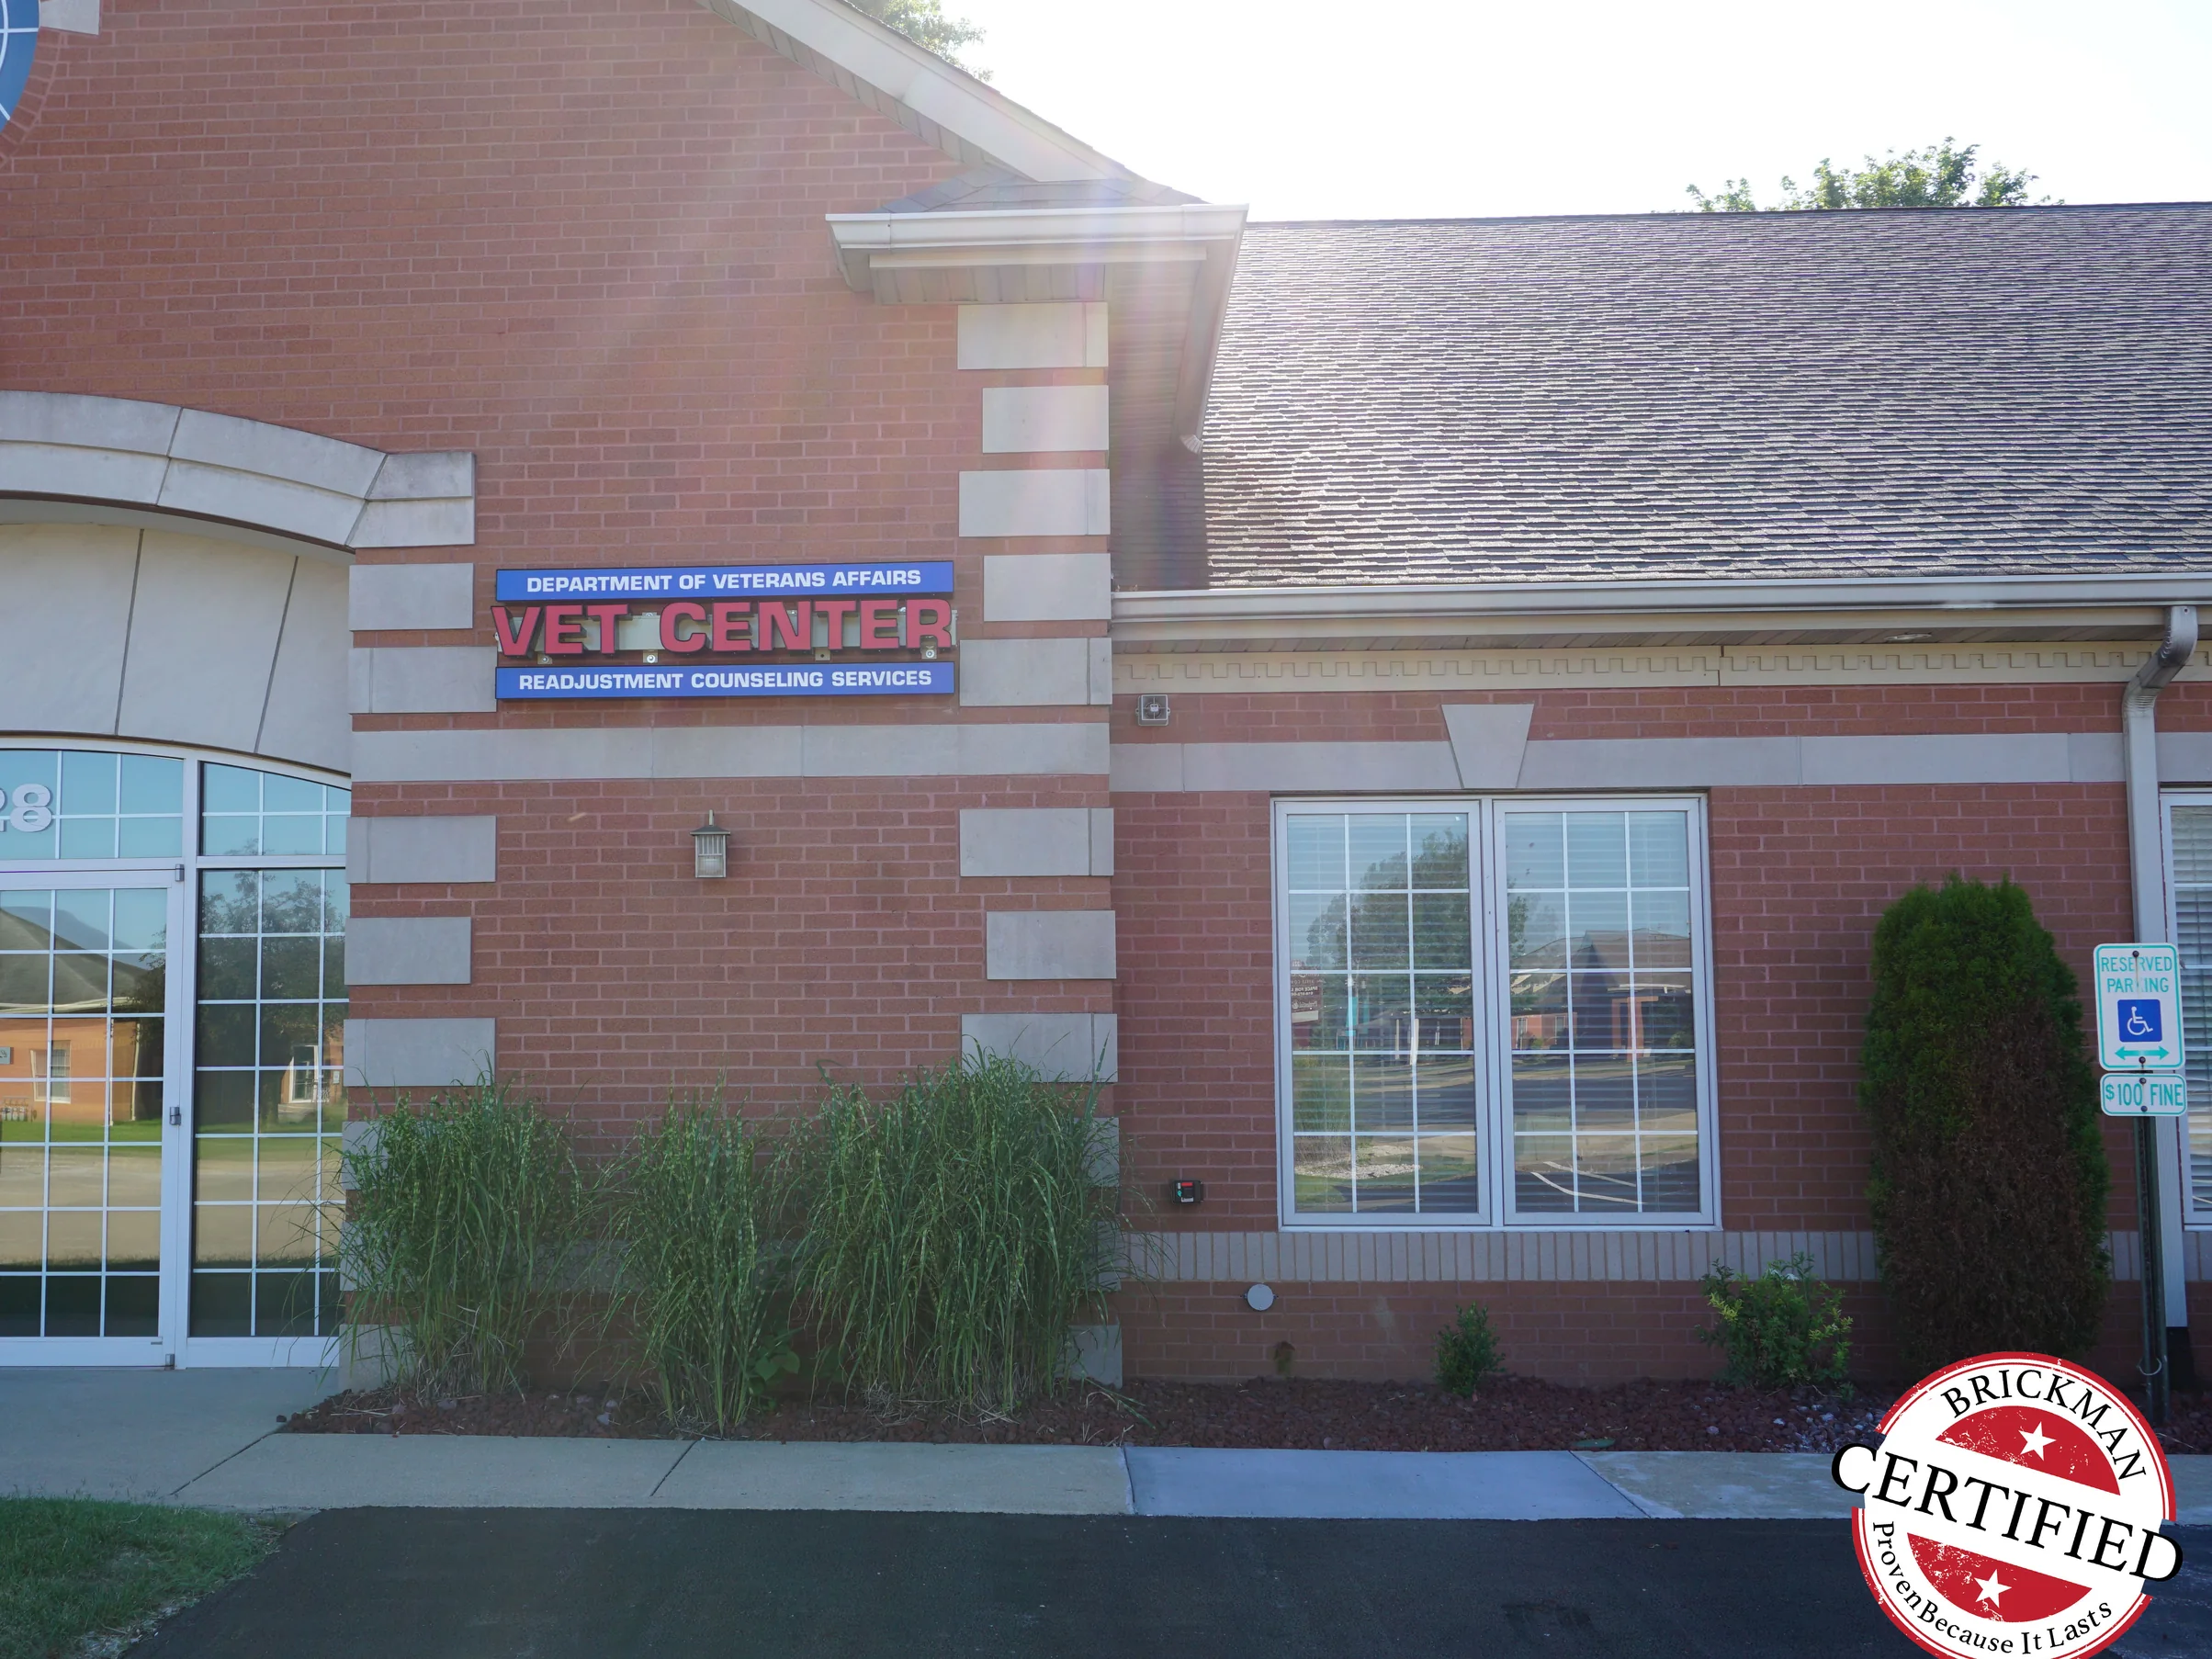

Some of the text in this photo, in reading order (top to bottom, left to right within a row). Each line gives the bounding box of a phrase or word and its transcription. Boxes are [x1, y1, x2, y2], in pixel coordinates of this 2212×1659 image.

[527, 570, 921, 592] DEPARTMENT OF VETERANS AFFAIRS
[491, 598, 954, 657] VET CENTER
[519, 670, 932, 690] READJUSTMENT COUNSELING SERVICES
[0, 784, 52, 832] 8
[2101, 956, 2172, 972] RESERVED
[2106, 977, 2170, 993] PARING
[2105, 1083, 2184, 1107] $100 FINE
